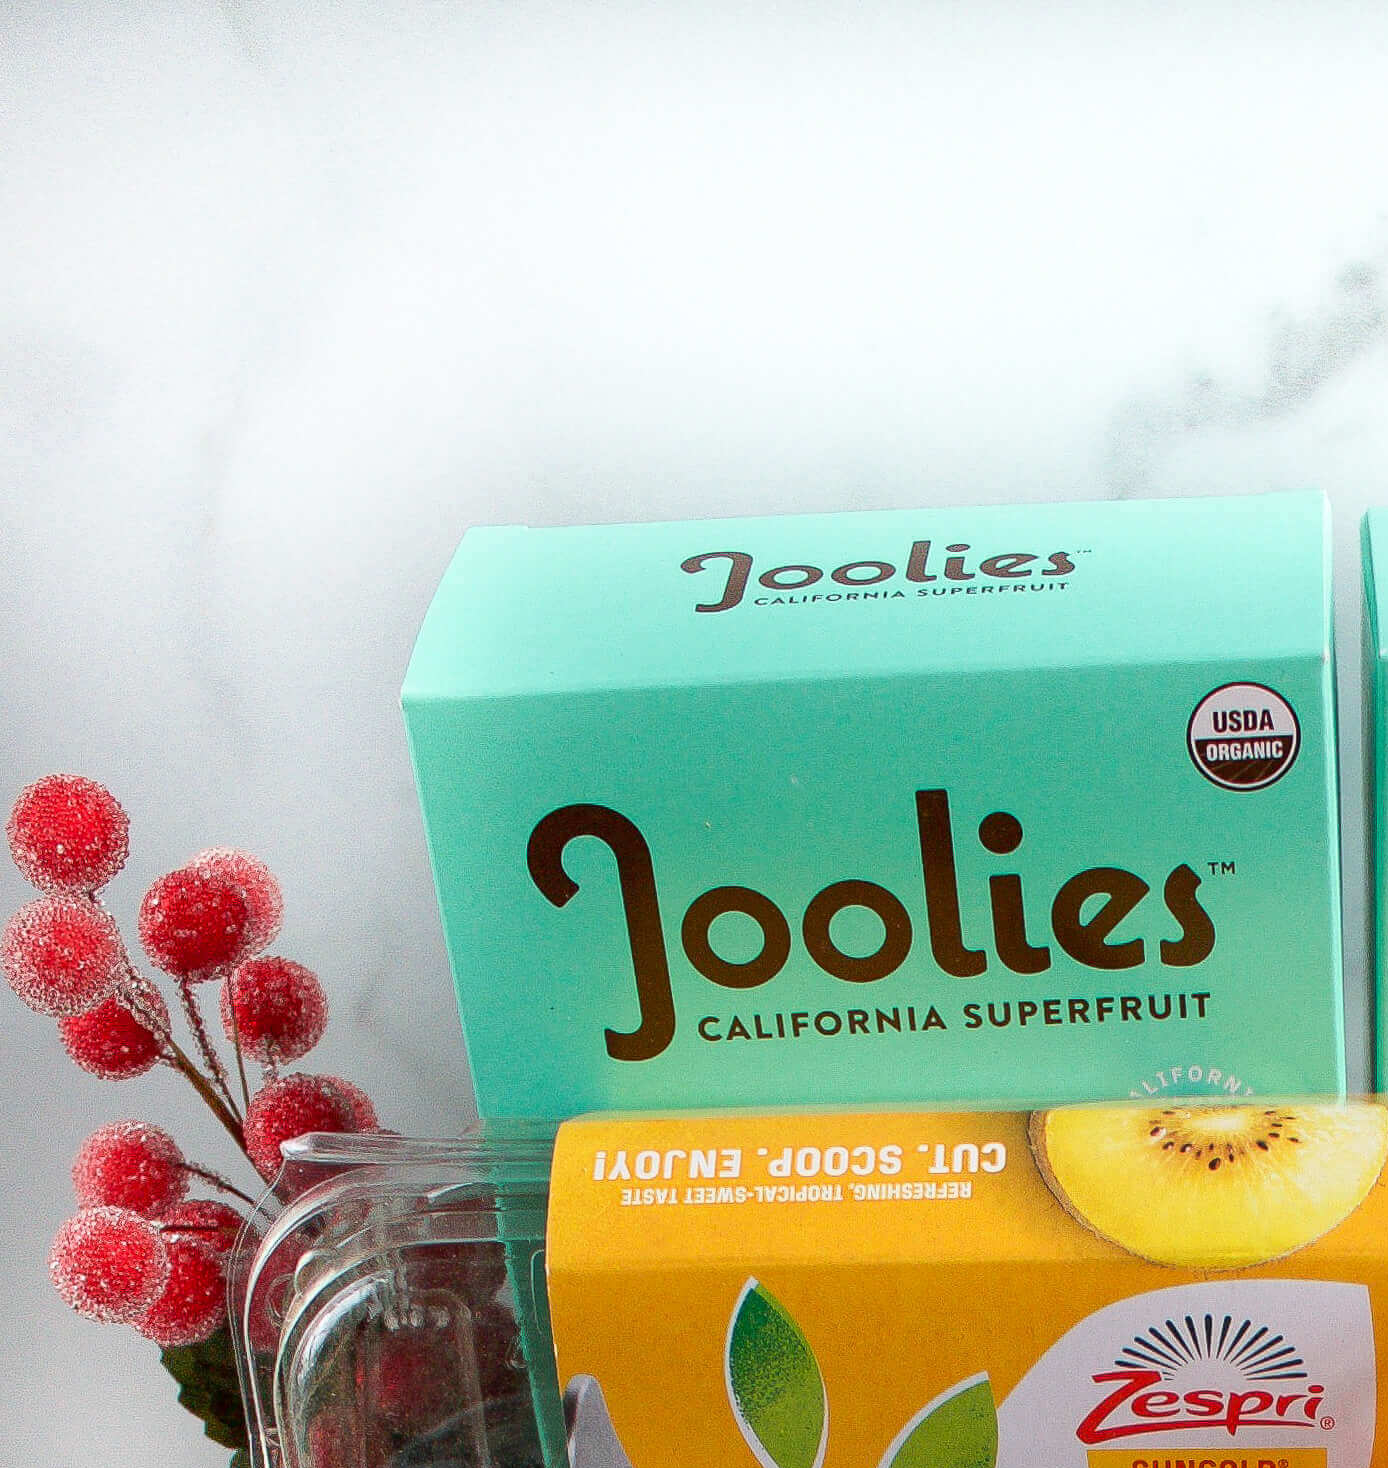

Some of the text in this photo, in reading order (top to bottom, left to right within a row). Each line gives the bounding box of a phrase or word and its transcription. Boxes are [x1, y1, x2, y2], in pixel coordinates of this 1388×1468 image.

[754, 582, 1070, 606] CALIFORNIA SUPERFRUIT
[1212, 709, 1275, 733] USDA
[1206, 740, 1284, 762] ORGANIC
[698, 991, 1212, 1042] CALIFORNIA SUPERFRUIT
[592, 1142, 1007, 1181] CUT. SCOOP. ENJOY!
[620, 1187, 678, 1206] TASTE
